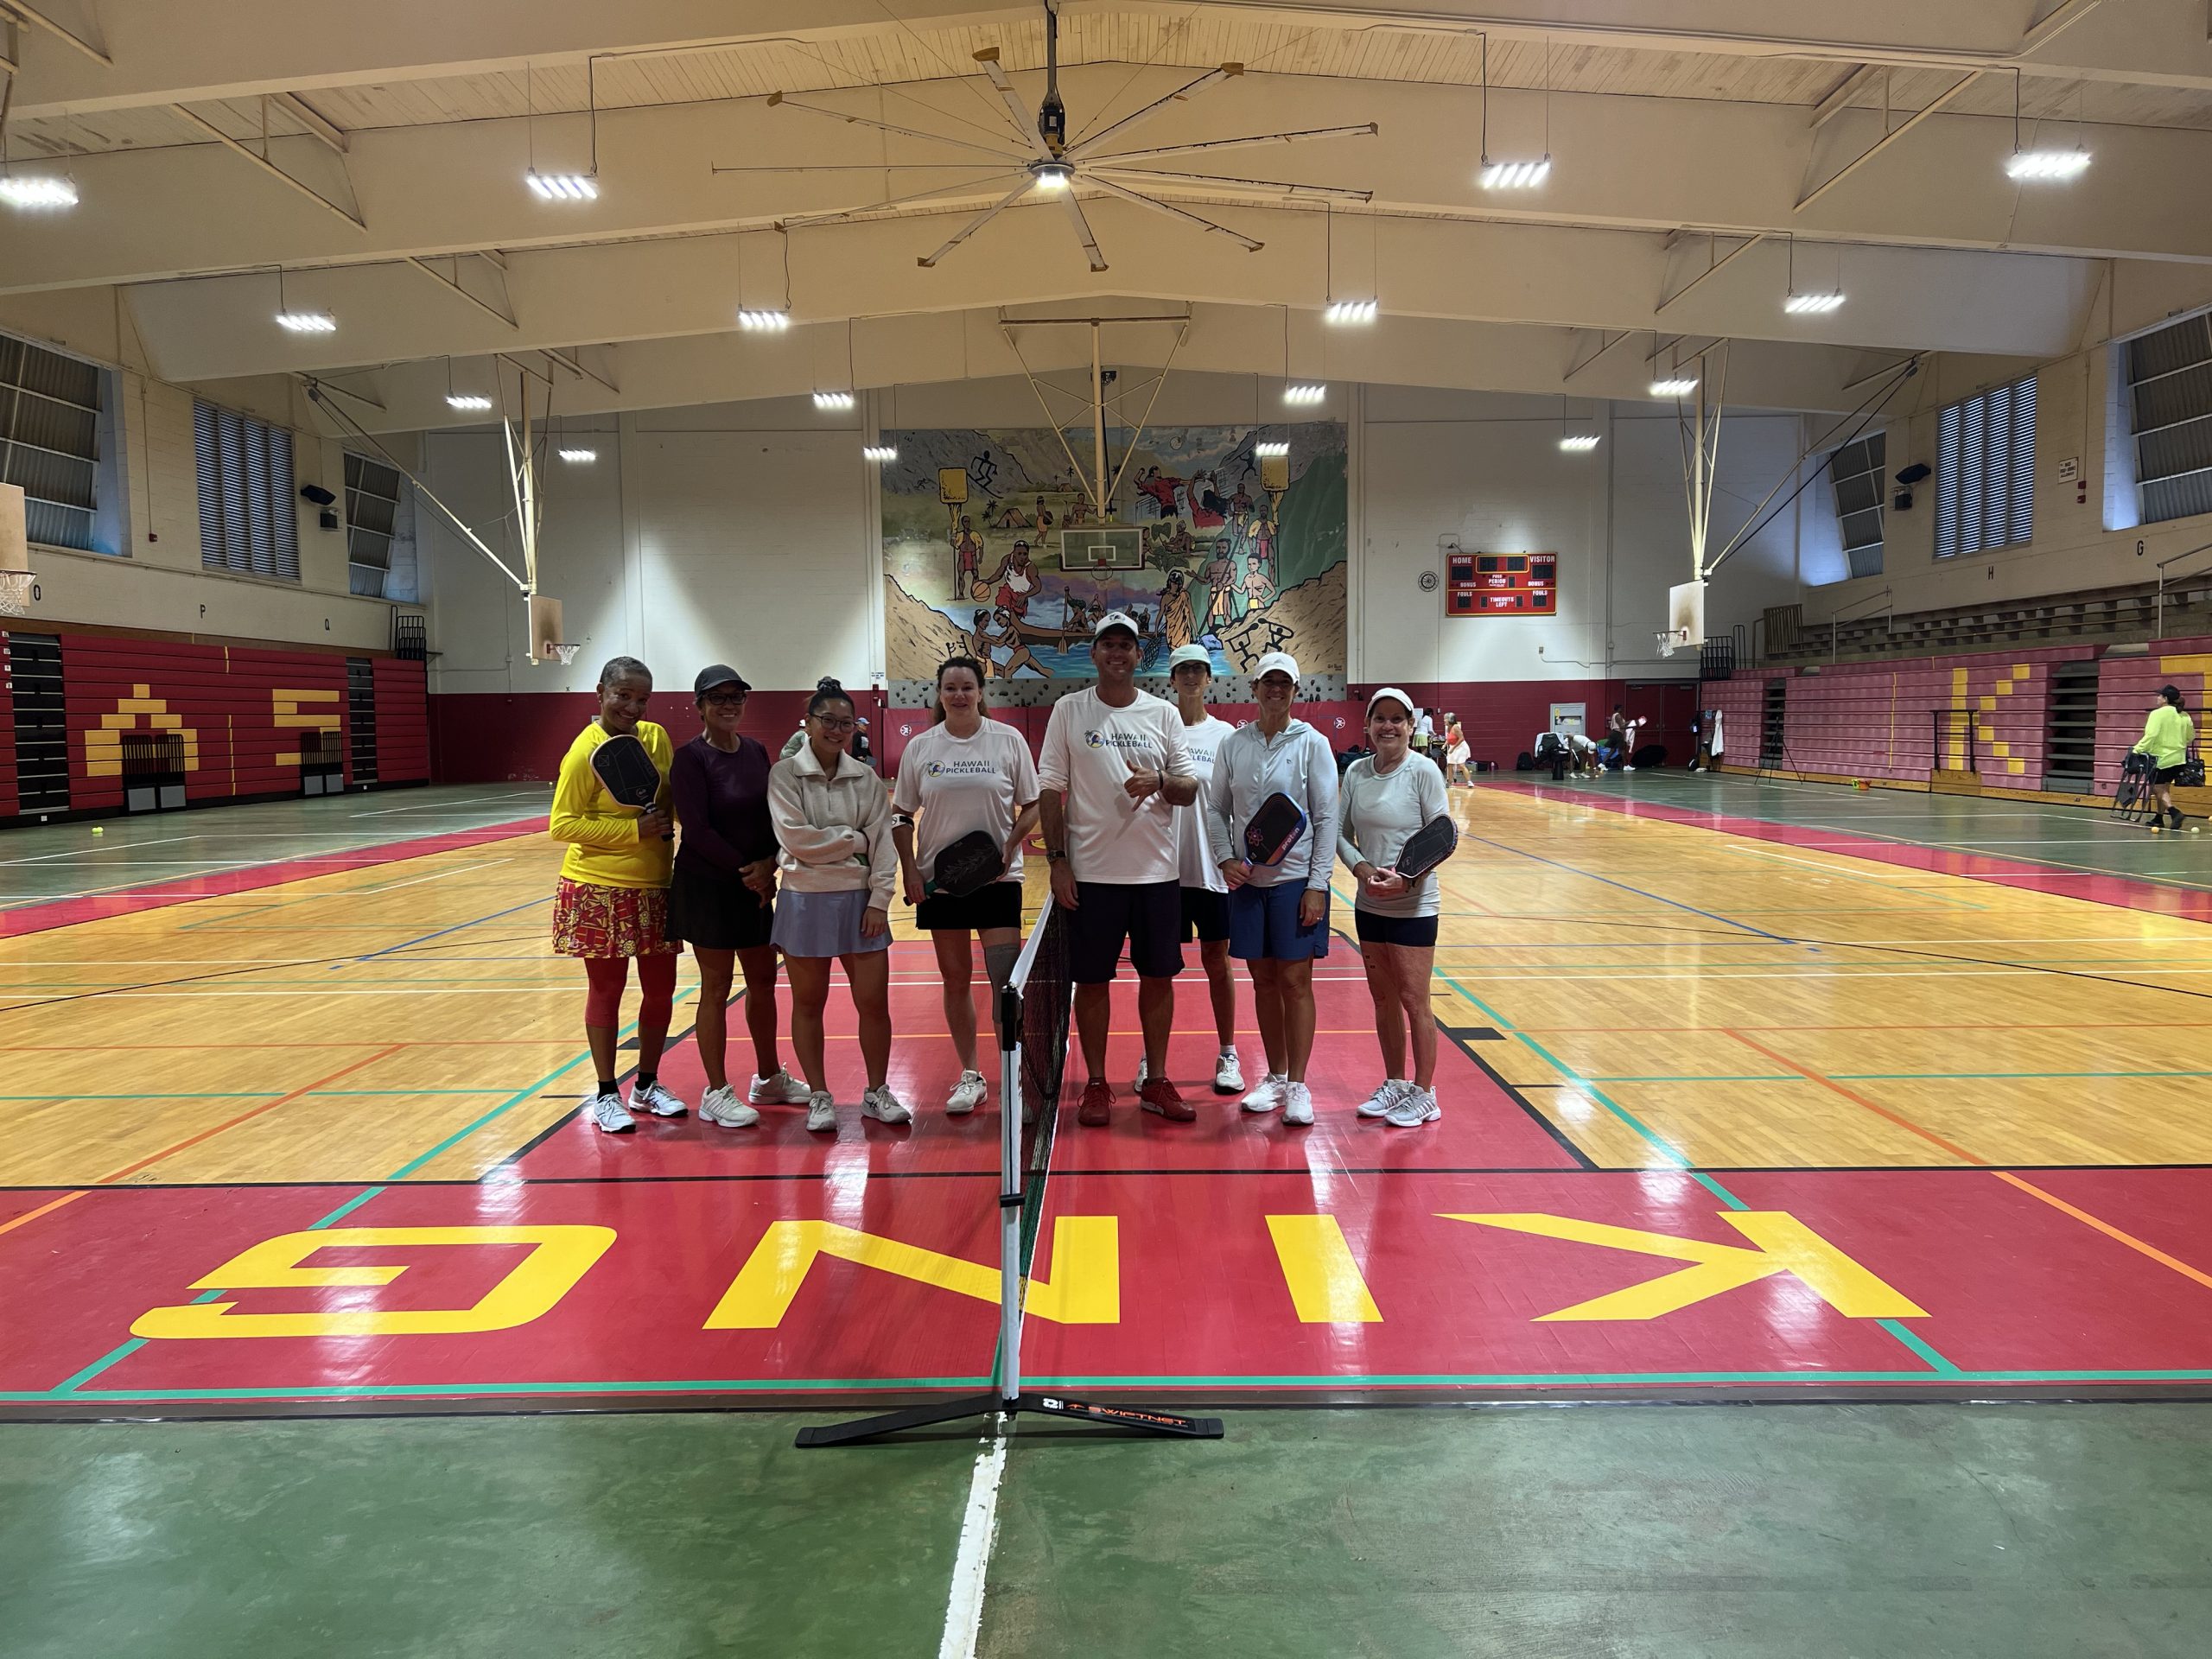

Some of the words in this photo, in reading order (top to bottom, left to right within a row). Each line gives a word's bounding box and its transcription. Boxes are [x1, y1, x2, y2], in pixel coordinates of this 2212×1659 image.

[2137, 540, 2145, 556] G
[1988, 566, 1994, 581] H
[200, 604, 207, 619] P
[324, 619, 330, 631] Q
[1190, 748, 1215, 757] AWAII
[1192, 755, 1215, 764] LEBAL
